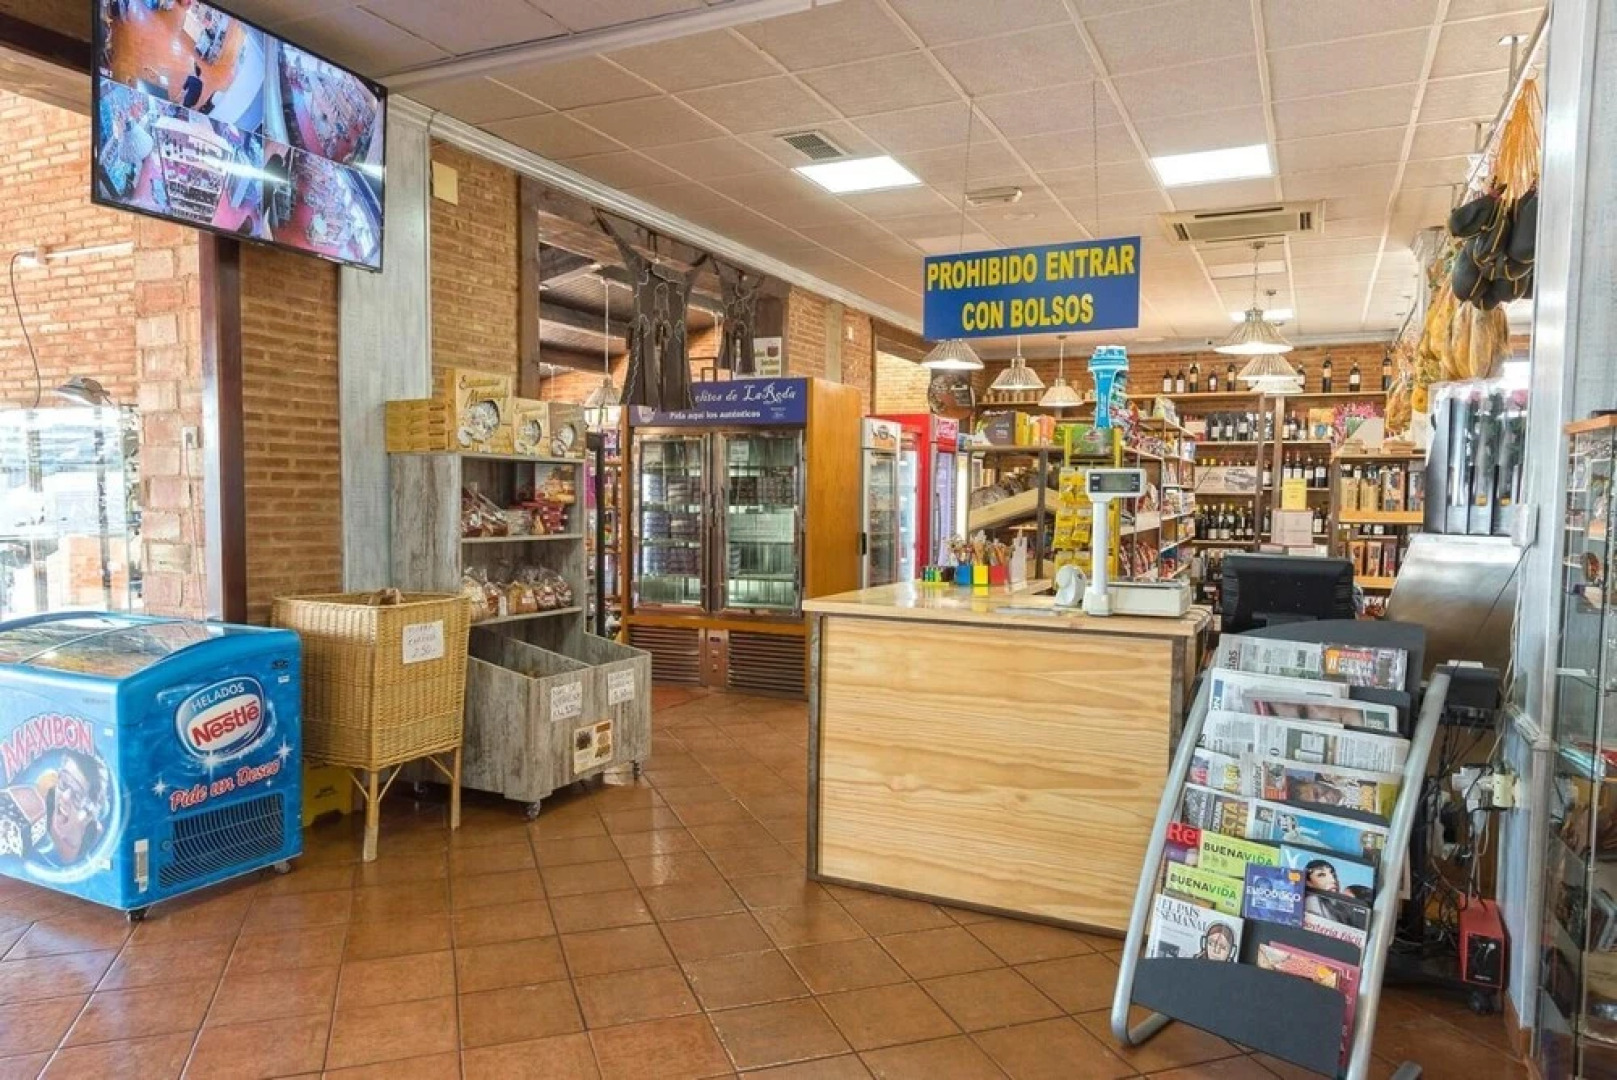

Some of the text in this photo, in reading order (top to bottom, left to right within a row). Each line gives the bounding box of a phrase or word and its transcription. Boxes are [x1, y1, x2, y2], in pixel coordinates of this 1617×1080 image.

[927, 244, 1136, 291] PROHIBIDO ENTRAR
[962, 293, 1094, 331] CON BOLSOS
[695, 389, 722, 402] elitos
[192, 682, 245, 712] HELADOS
[191, 700, 259, 746] Nestlé
[2, 714, 95, 784] MAXIBON
[170, 757, 280, 812] Pide un Deseo
[1204, 841, 1274, 867] BUENAVIDA
[1170, 872, 1238, 900] BUENAVIDA
